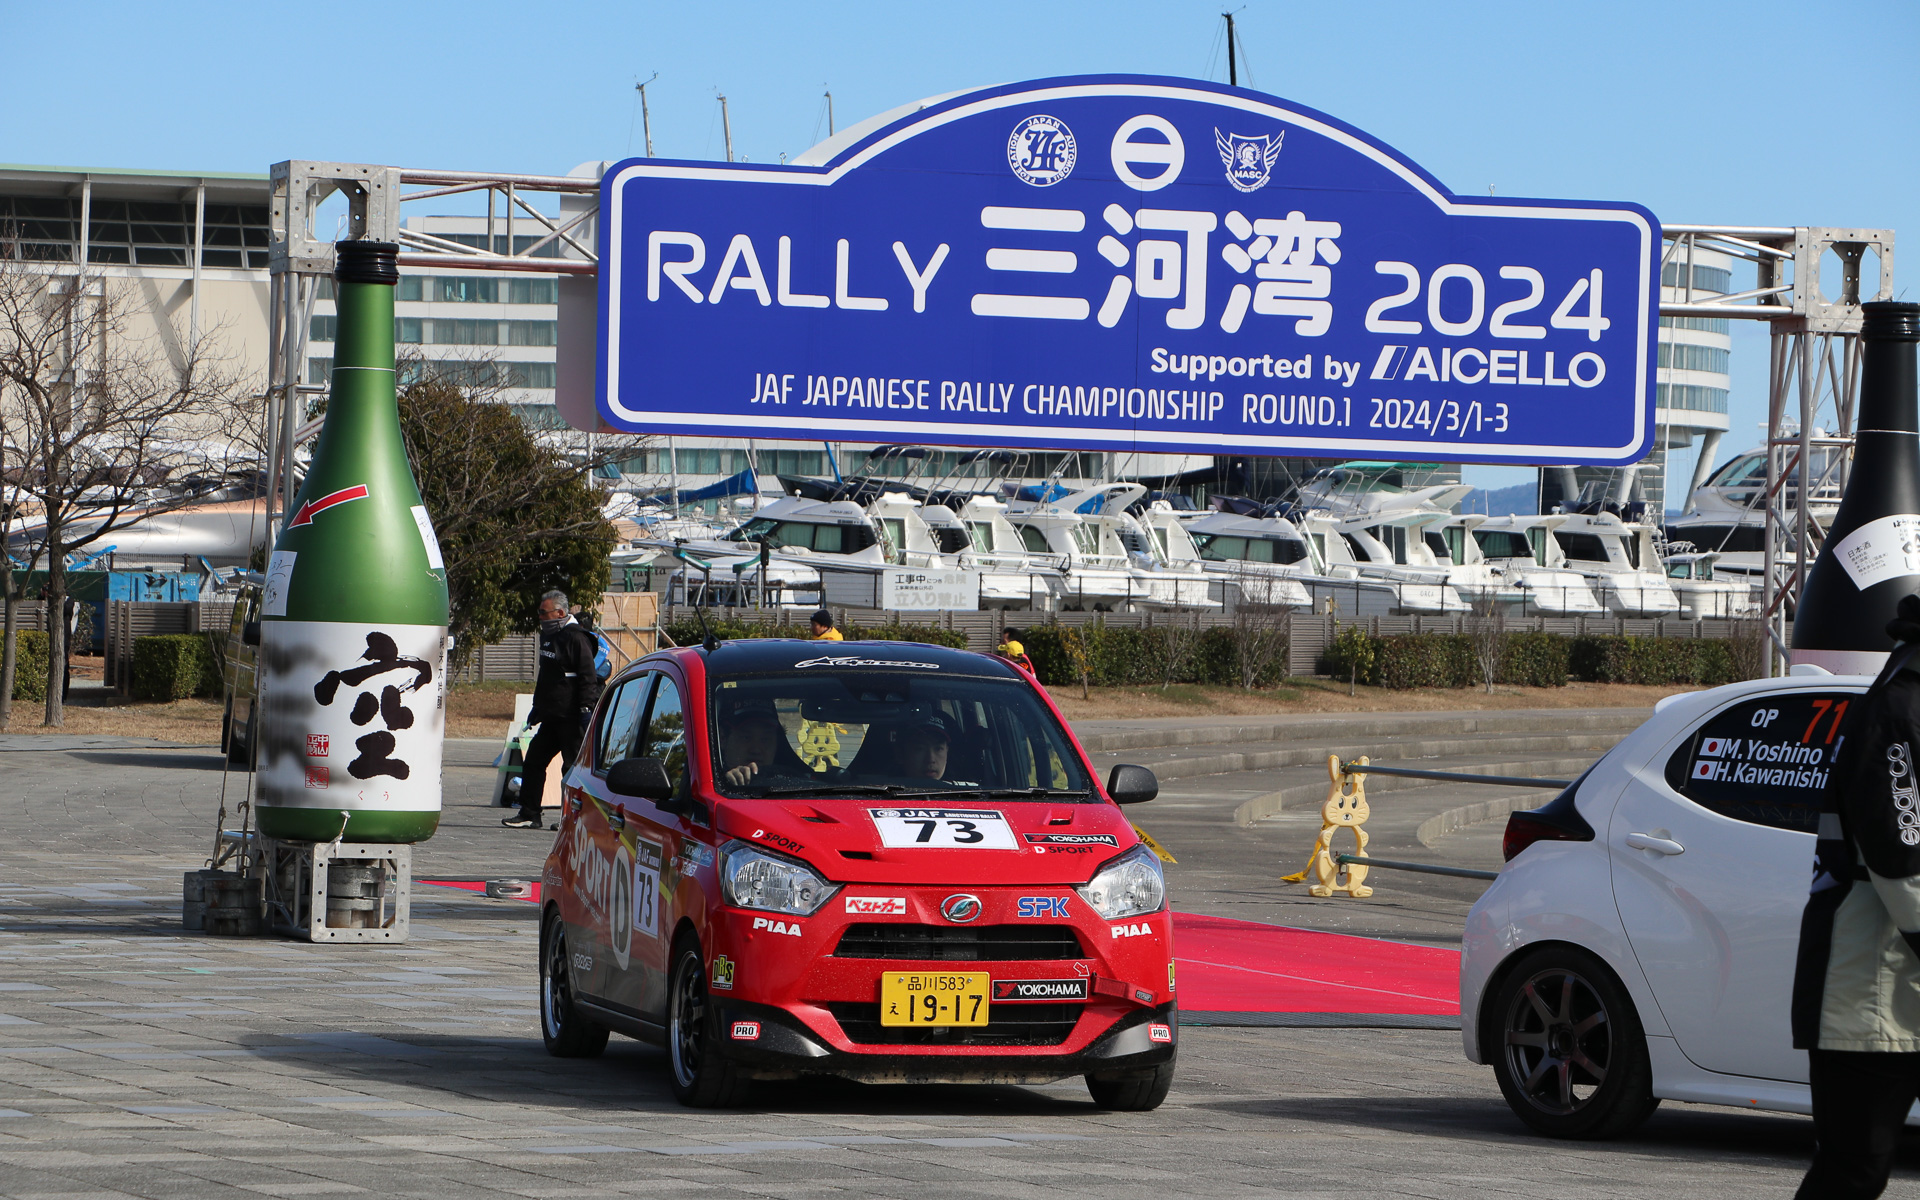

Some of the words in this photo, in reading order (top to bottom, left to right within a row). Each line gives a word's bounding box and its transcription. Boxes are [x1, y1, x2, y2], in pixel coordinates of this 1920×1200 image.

[1027, 117, 1061, 129] JAPAN
[1235, 170, 1262, 179] MASC
[647, 231, 951, 315] RALLY
[970, 203, 1342, 337] 三河湾
[1364, 260, 1611, 342] 2024
[1150, 348, 1312, 383] Supported
[1324, 356, 1361, 388] by
[750, 373, 795, 405] JAF
[802, 374, 930, 411] JAPANESE
[940, 381, 1015, 414] RALLY
[1023, 384, 1224, 422] CHAMPIONSHIP
[1242, 393, 1351, 427] ROUND.1
[1369, 398, 1509, 437] 2024/3/1-3
[1848, 541, 1872, 558] 日本酒
[895, 592, 966, 606] 立入り禁止
[314, 631, 432, 782] 空
[1751, 708, 1779, 728] OP
[1801, 699, 1849, 745] 71
[1720, 738, 1823, 765] M.Yoshino
[1713, 761, 1830, 789] H.Kawanishi
[1886, 741, 1920, 846] sparco
[904, 810, 940, 818] JAF
[752, 829, 764, 838] D
[763, 832, 805, 853] SPORT
[903, 820, 984, 844] 73
[1048, 835, 1114, 844] YOKOHAMA
[1135, 830, 1155, 848] UNLOP
[1033, 845, 1046, 854] D
[1048, 846, 1094, 854] SPORT
[570, 816, 610, 914] SPORT
[638, 872, 653, 928] 73
[846, 898, 905, 913] ベストカー
[1018, 896, 1070, 918] SPK
[753, 917, 801, 937] PIAA
[1111, 922, 1152, 939] PIAA
[714, 957, 733, 982] DRS
[1017, 984, 1082, 996] YOKOHAMA
[889, 1002, 899, 1015] え
[909, 994, 983, 1022] 19-17
[736, 1027, 754, 1036] PRO
[1152, 1028, 1168, 1038] PRO
